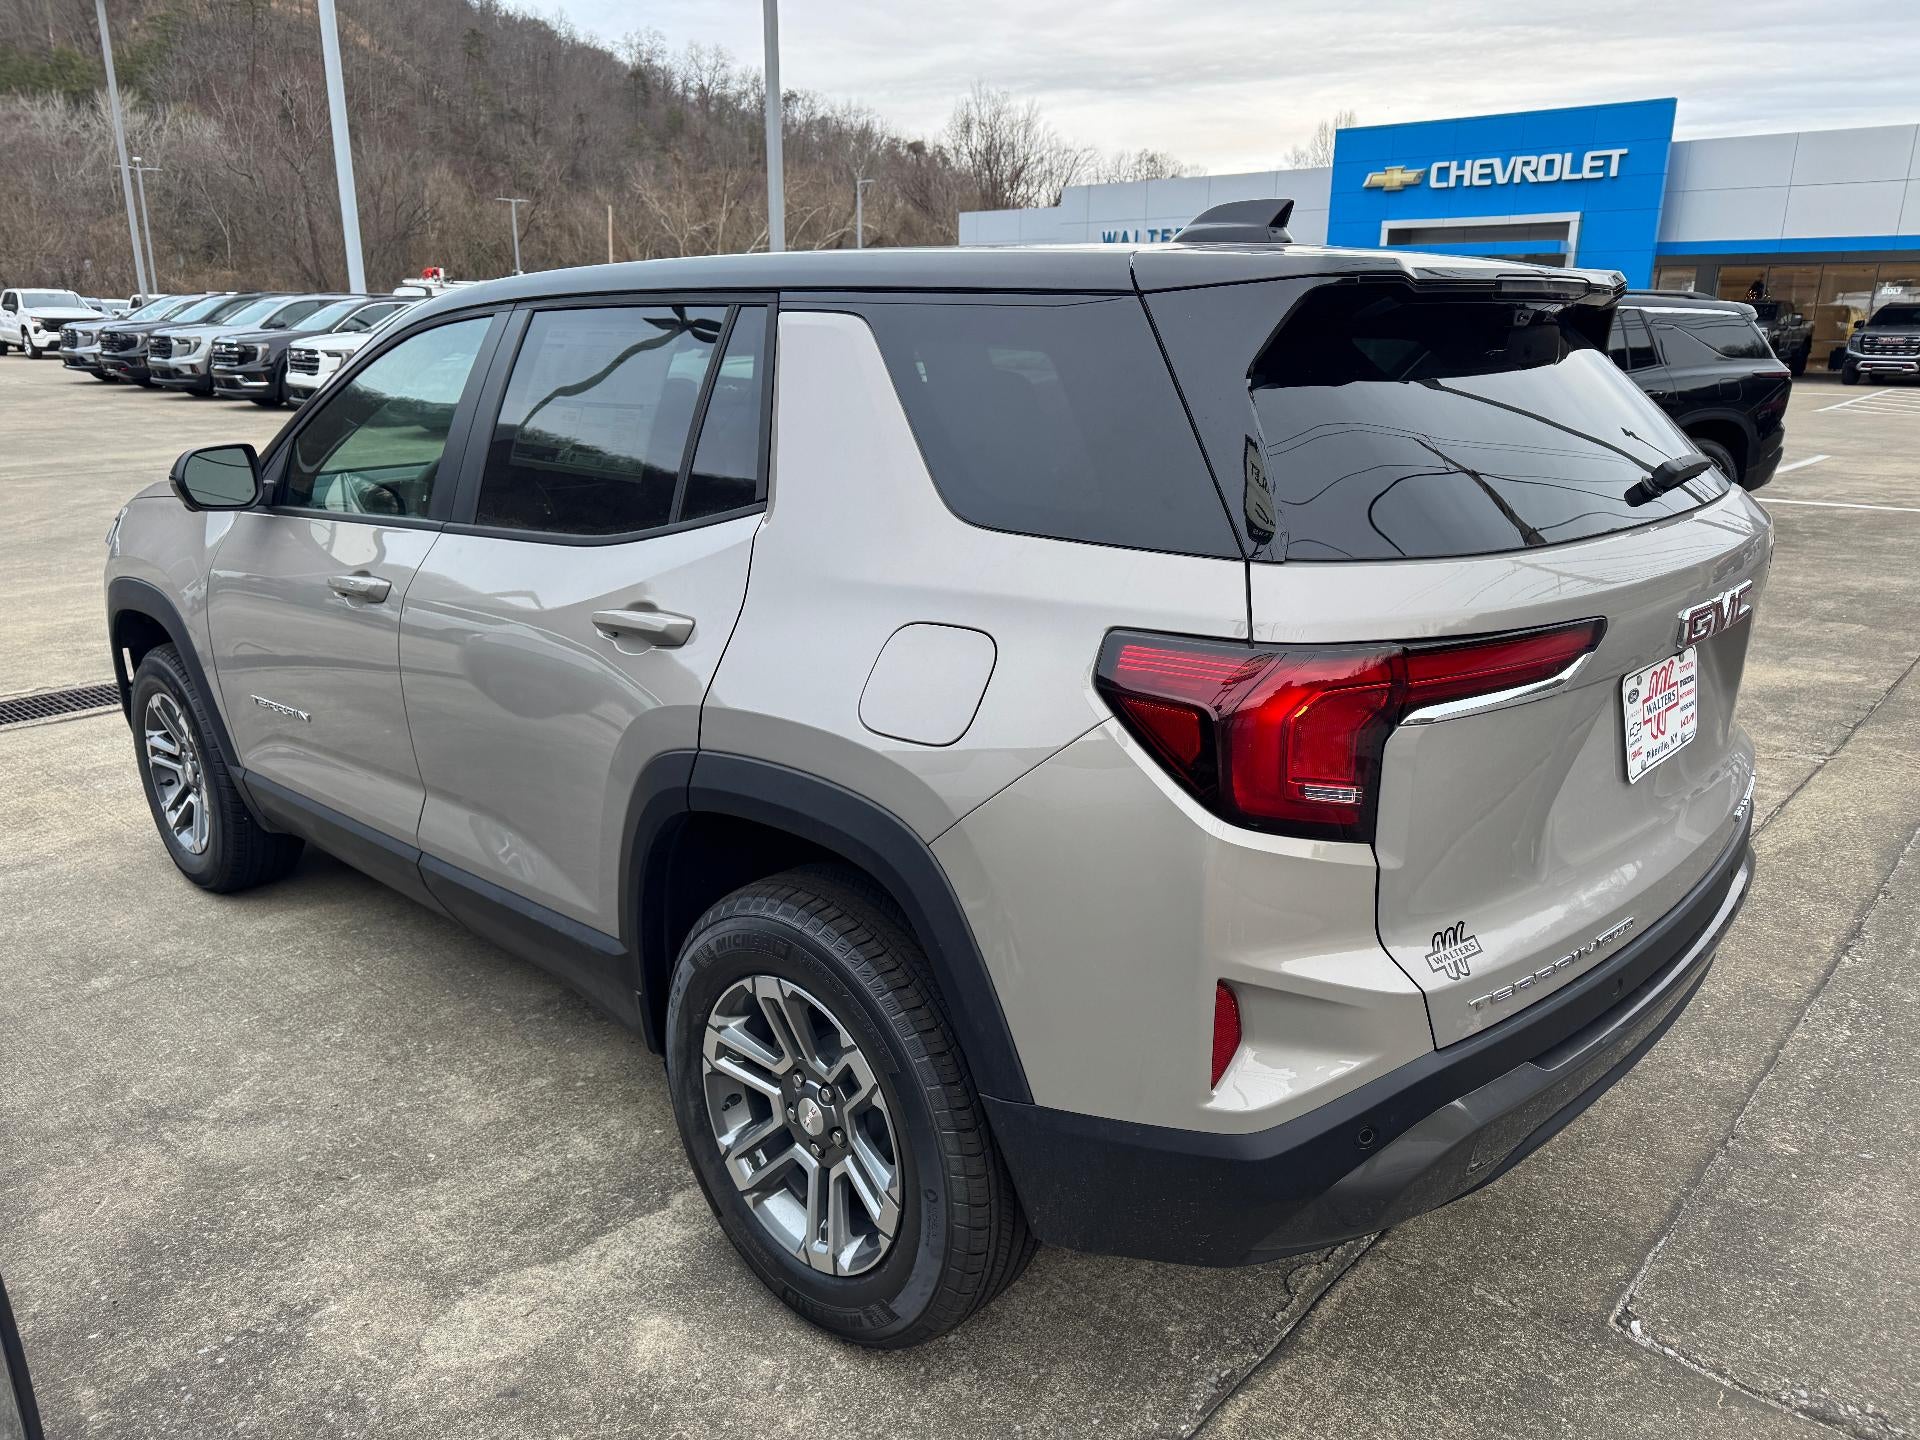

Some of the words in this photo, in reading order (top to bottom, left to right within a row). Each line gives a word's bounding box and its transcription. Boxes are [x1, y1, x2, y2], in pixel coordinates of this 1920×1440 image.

[1430, 148, 1629, 190] CHEVROLET
[1882, 286, 1903, 295] BOLT
[1677, 579, 1753, 648] GMC
[1646, 689, 1676, 716] WALTERS
[1432, 941, 1477, 966] WALTERS
